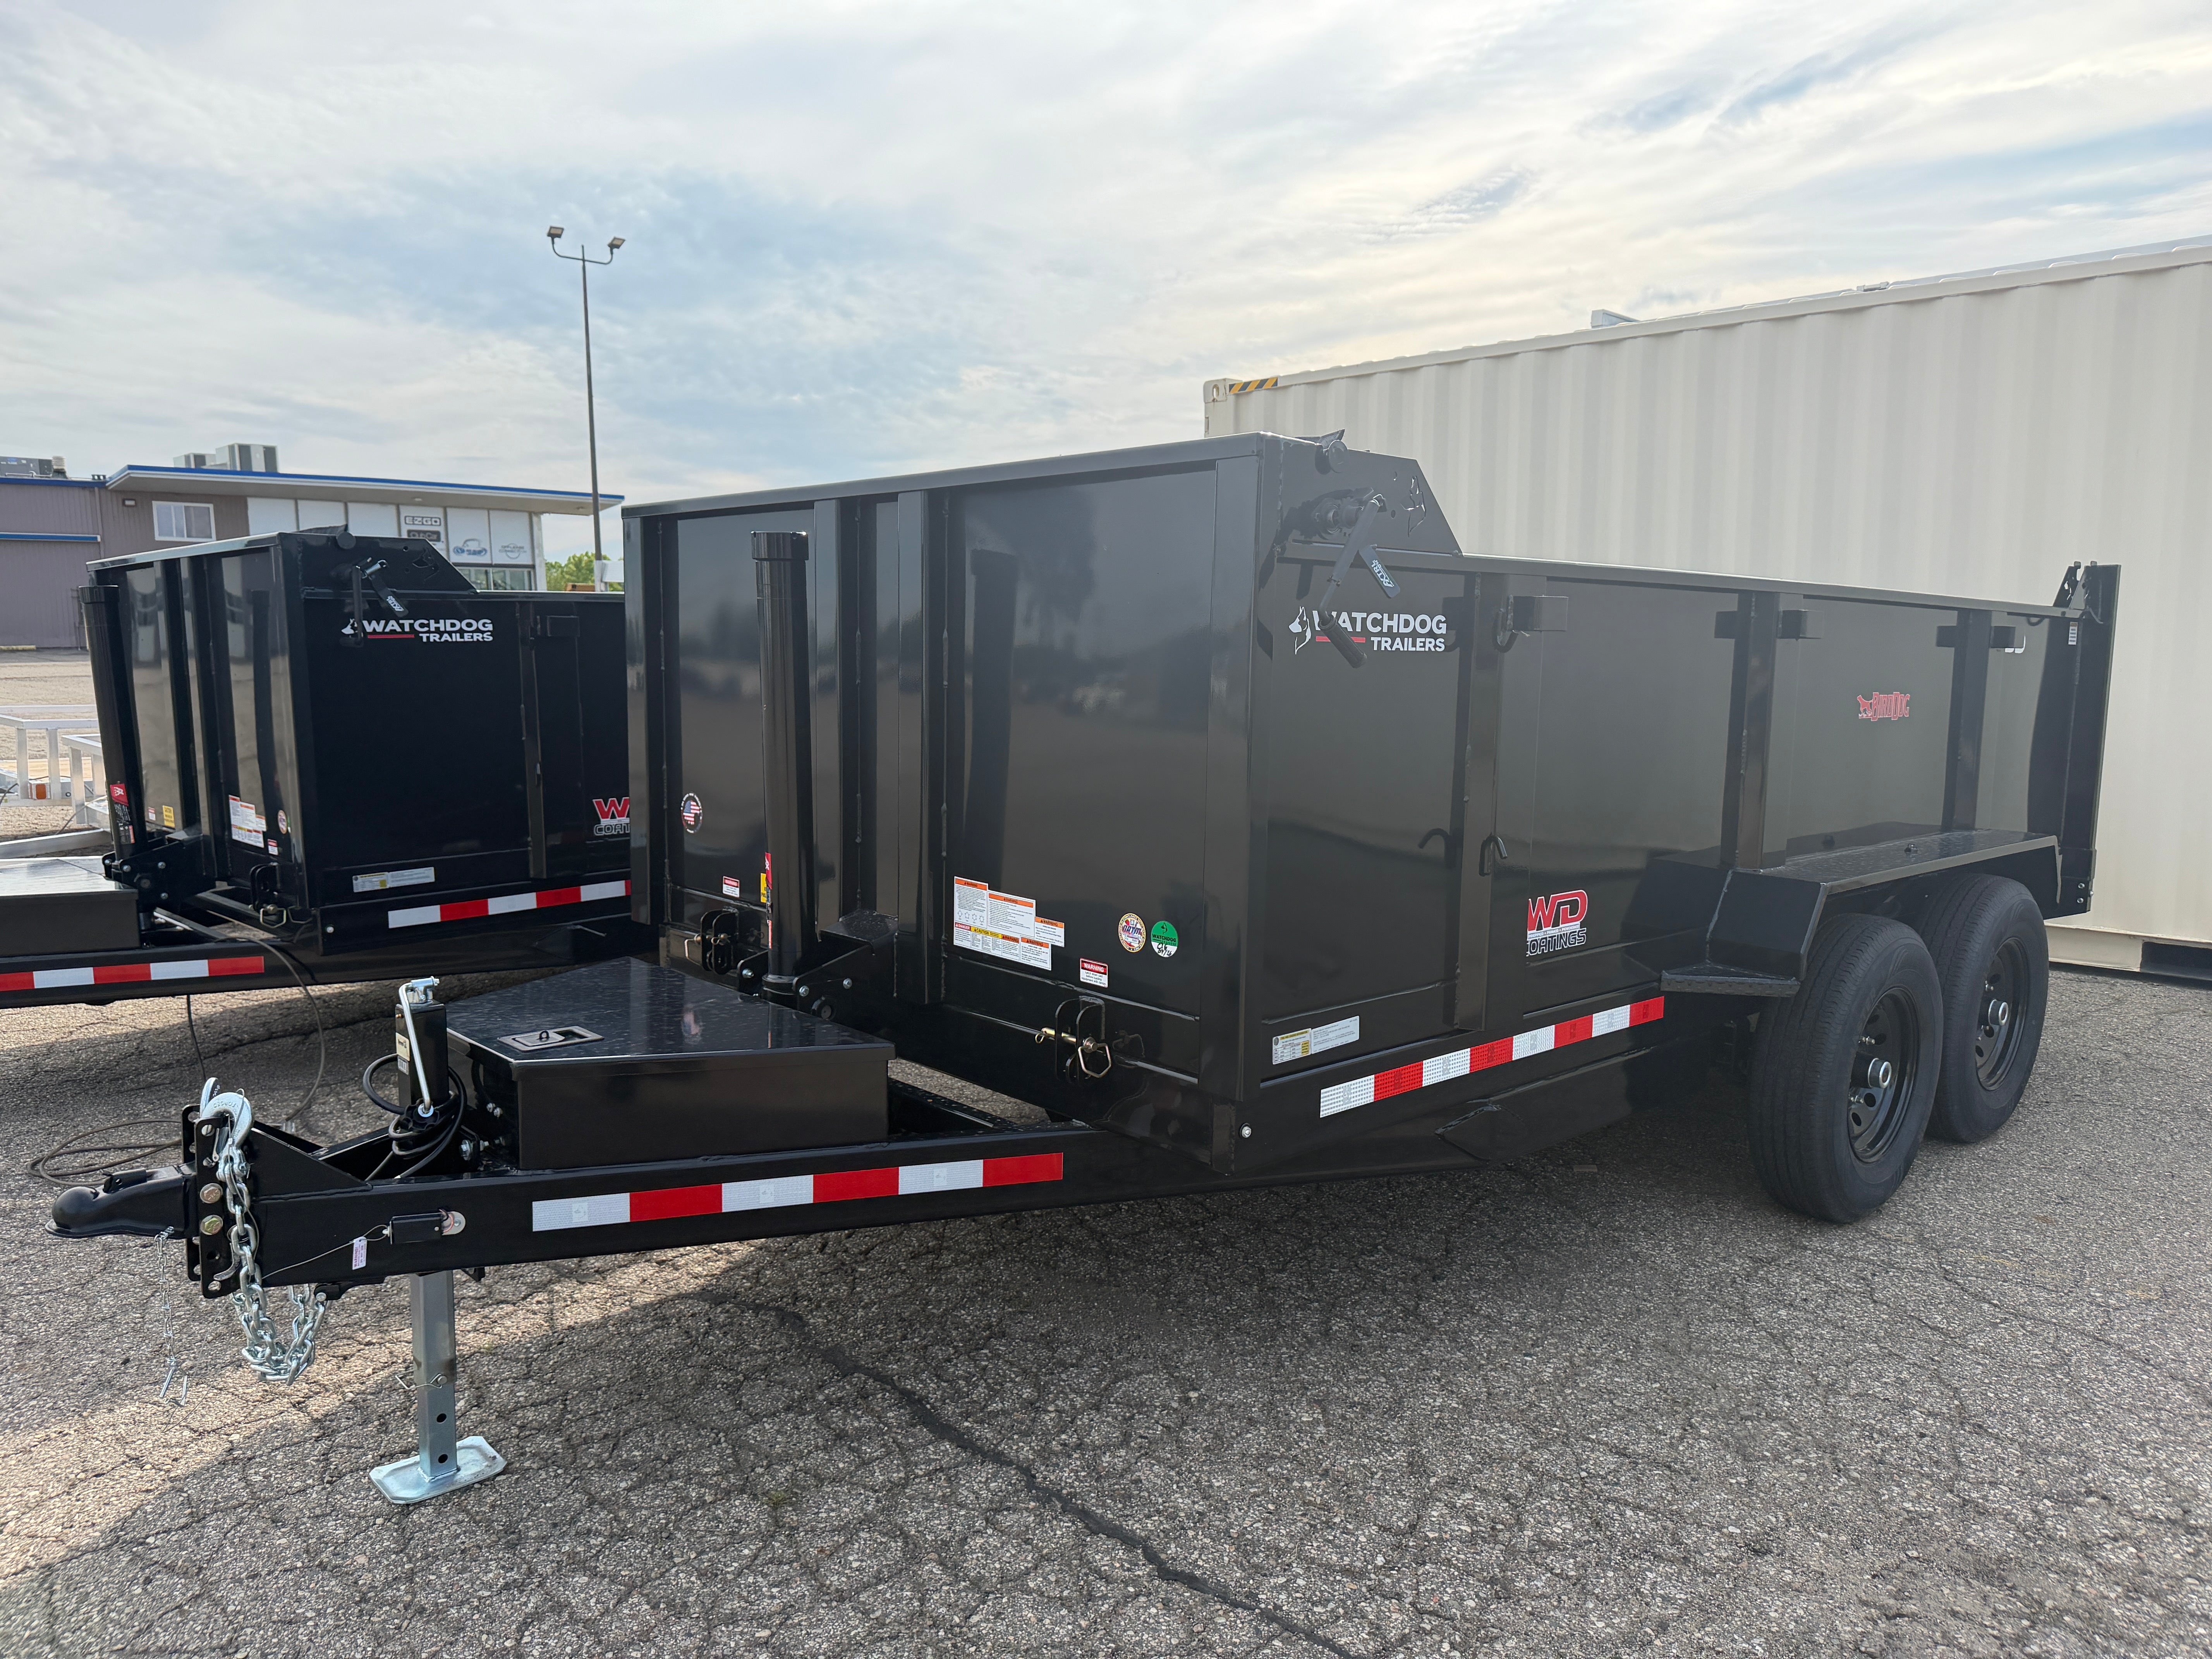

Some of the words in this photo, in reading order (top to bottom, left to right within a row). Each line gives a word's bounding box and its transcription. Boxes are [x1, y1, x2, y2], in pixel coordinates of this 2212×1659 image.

[362, 619, 493, 632] WATCHDOG
[419, 632, 493, 642] TRAILERS
[1370, 637, 1445, 651] TRAILERS
[1527, 890, 1588, 932] WD
[1152, 934, 1176, 942] WATCHDOG
[1526, 928, 1587, 957] OATINGS
[1084, 963, 1104, 972] WARNING
